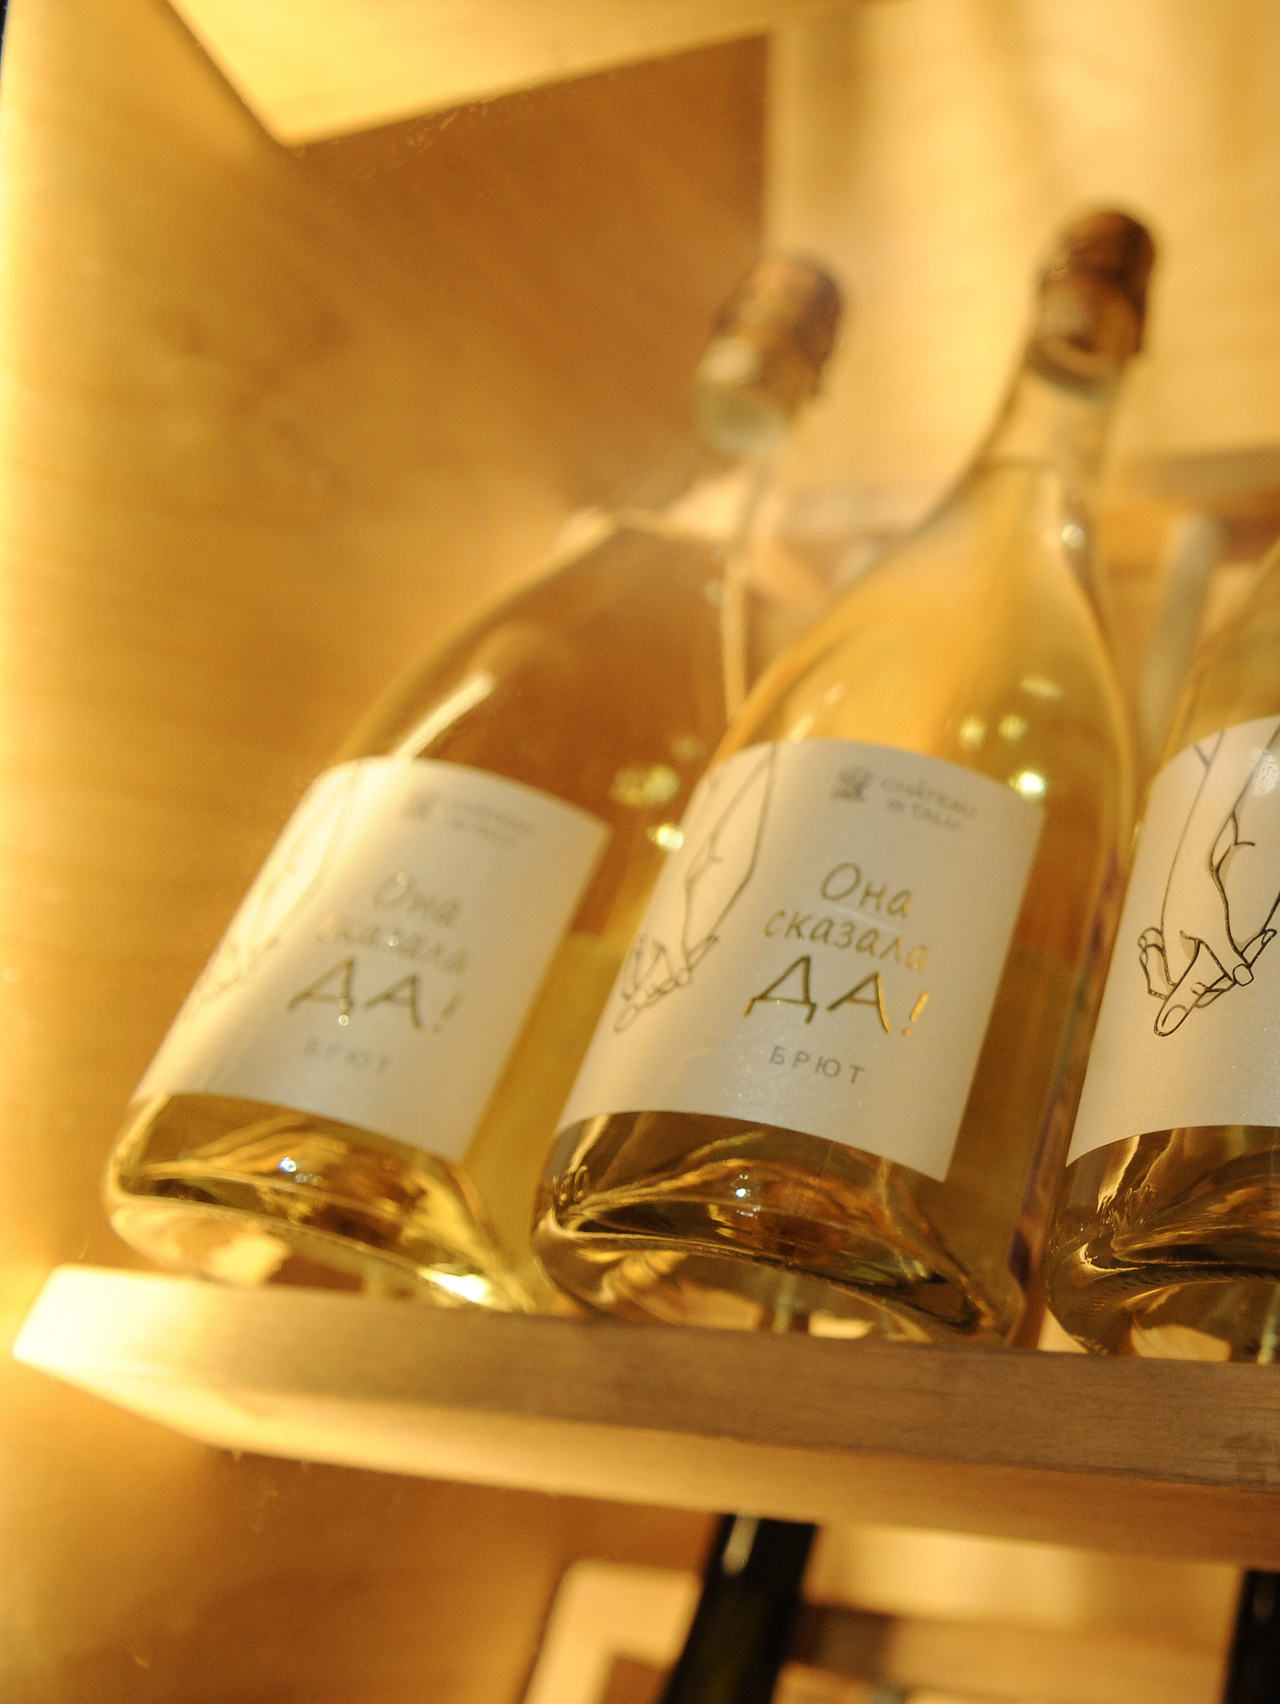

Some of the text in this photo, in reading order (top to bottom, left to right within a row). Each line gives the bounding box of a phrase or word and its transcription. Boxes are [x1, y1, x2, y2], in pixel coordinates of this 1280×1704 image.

[820, 862, 914, 919] Она
[764, 907, 930, 973] сказала
[744, 955, 930, 1037] ДА!
[768, 1046, 866, 1085] БРЮТ
